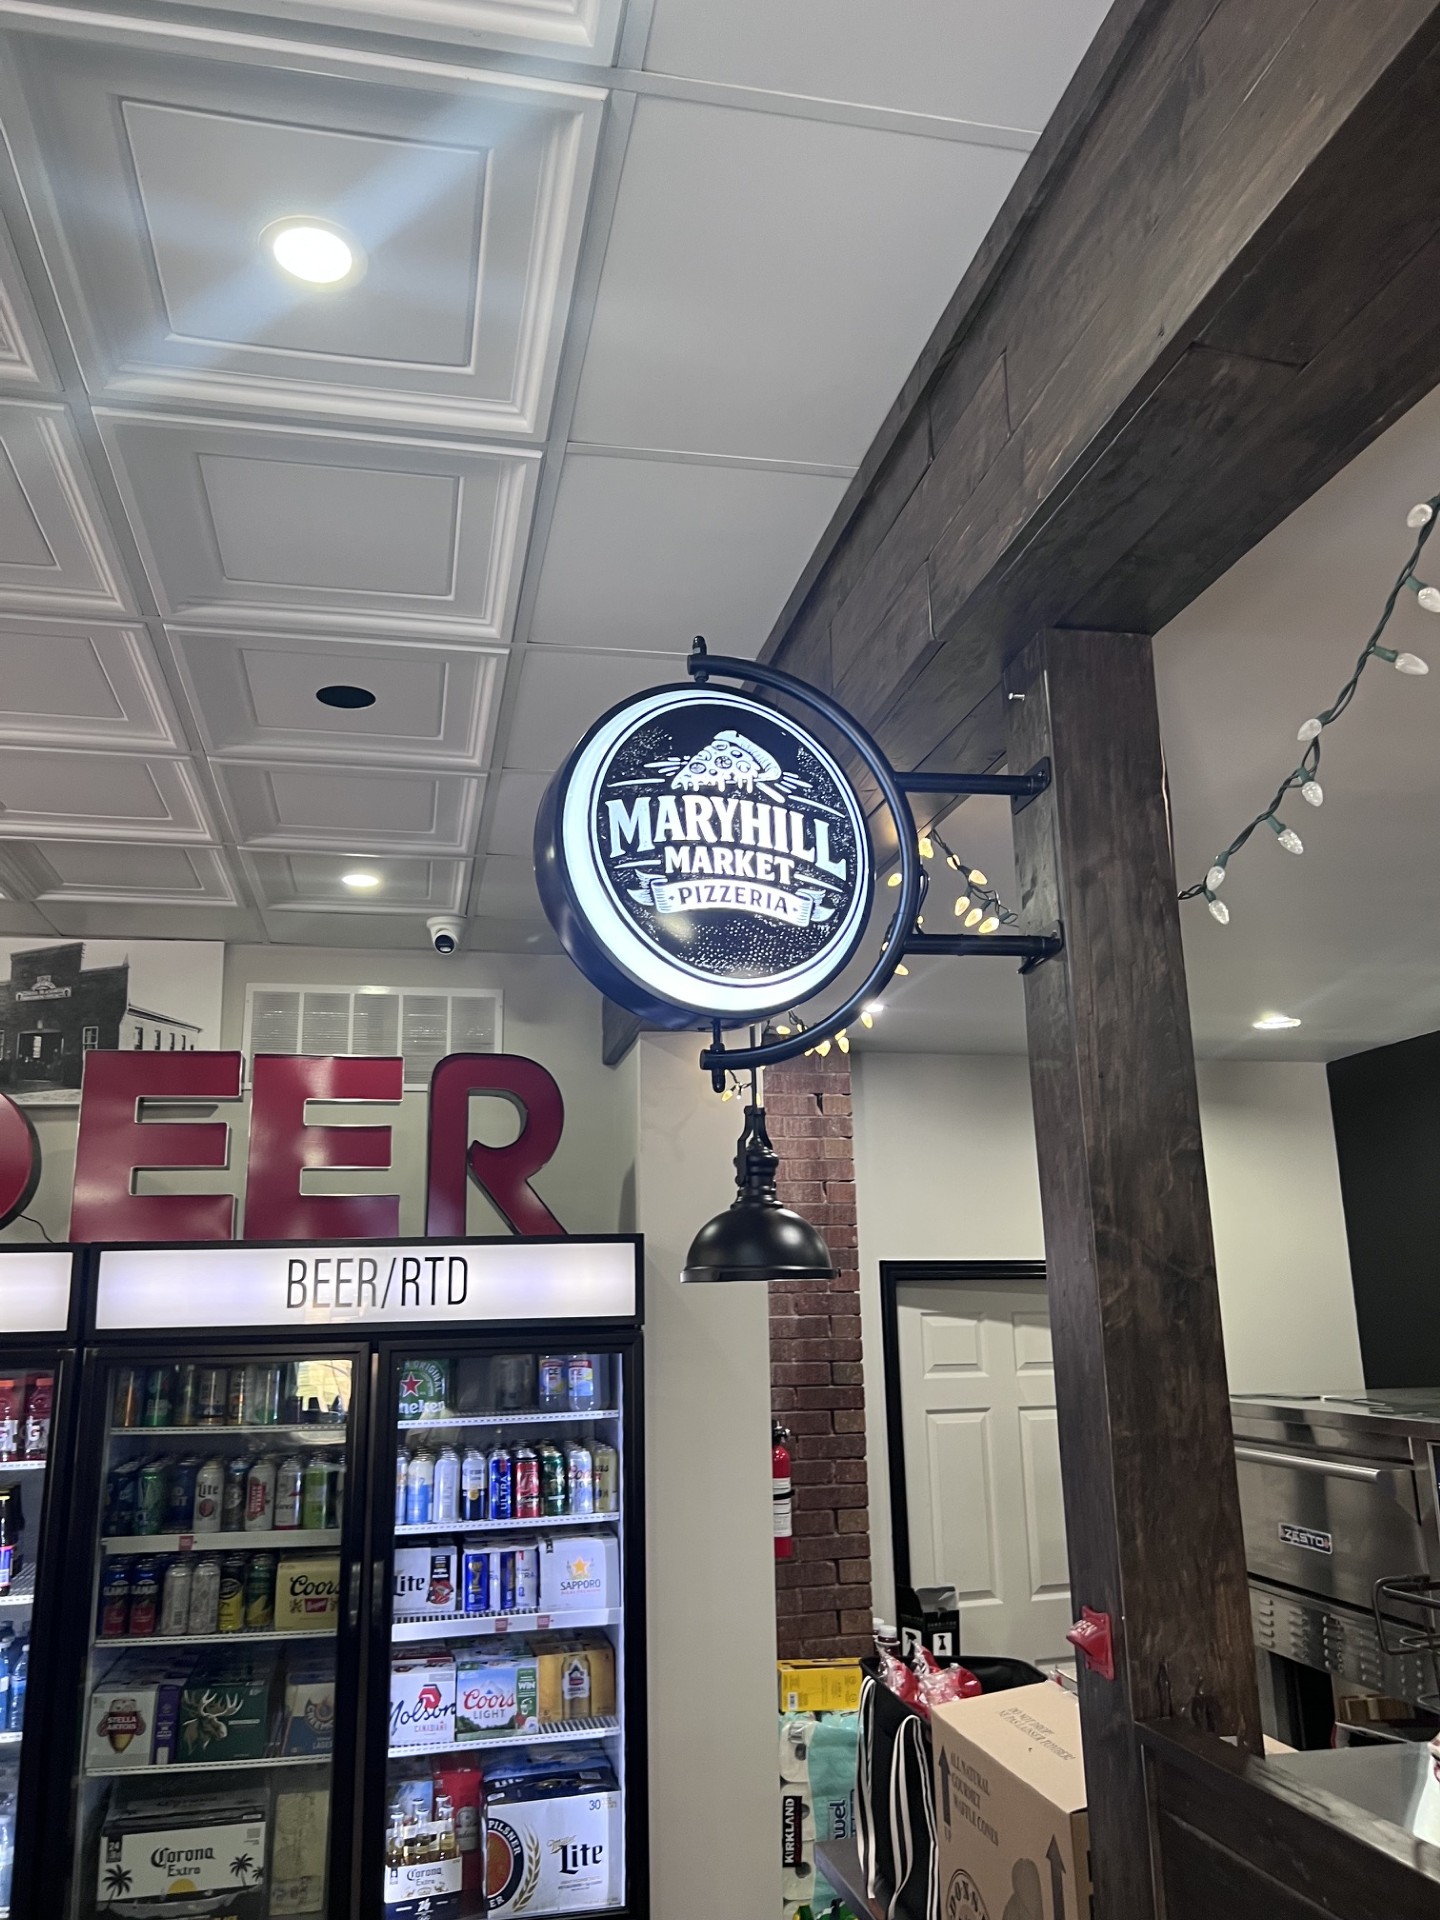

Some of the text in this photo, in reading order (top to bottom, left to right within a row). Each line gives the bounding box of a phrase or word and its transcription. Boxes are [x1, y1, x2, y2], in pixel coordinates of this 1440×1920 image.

[605, 795, 847, 881] MARYHILL
[664, 845, 795, 885] MARKET
[677, 885, 789, 915] PIZZERIA
[0, 1049, 568, 1242] EER
[286, 1256, 469, 1309] BEER/RTD
[398, 1400, 445, 1415] neken
[198, 1482, 220, 1498] Lite
[500, 1475, 509, 1511] ULTRA
[1284, 1528, 1325, 1547] ZESTO
[560, 1579, 601, 1591] SAPPORO
[518, 1681, 536, 1690] WIN
[464, 1688, 516, 1710] Coors
[107, 1716, 137, 1724] STELLA
[473, 1709, 505, 1720] LIGHT
[107, 1723, 137, 1731] ARTOIS
[588, 1799, 601, 1811] 30
[830, 1799, 846, 1839] wel
[488, 1820, 522, 1856] PILSNER
[784, 1798, 795, 1864] KIRKLAND
[151, 1847, 216, 1869] Corona
[559, 1844, 603, 1875] Lite
[167, 1863, 201, 1877] Extra
[407, 1867, 443, 1881] Corona
[415, 1879, 435, 1887] Extra
